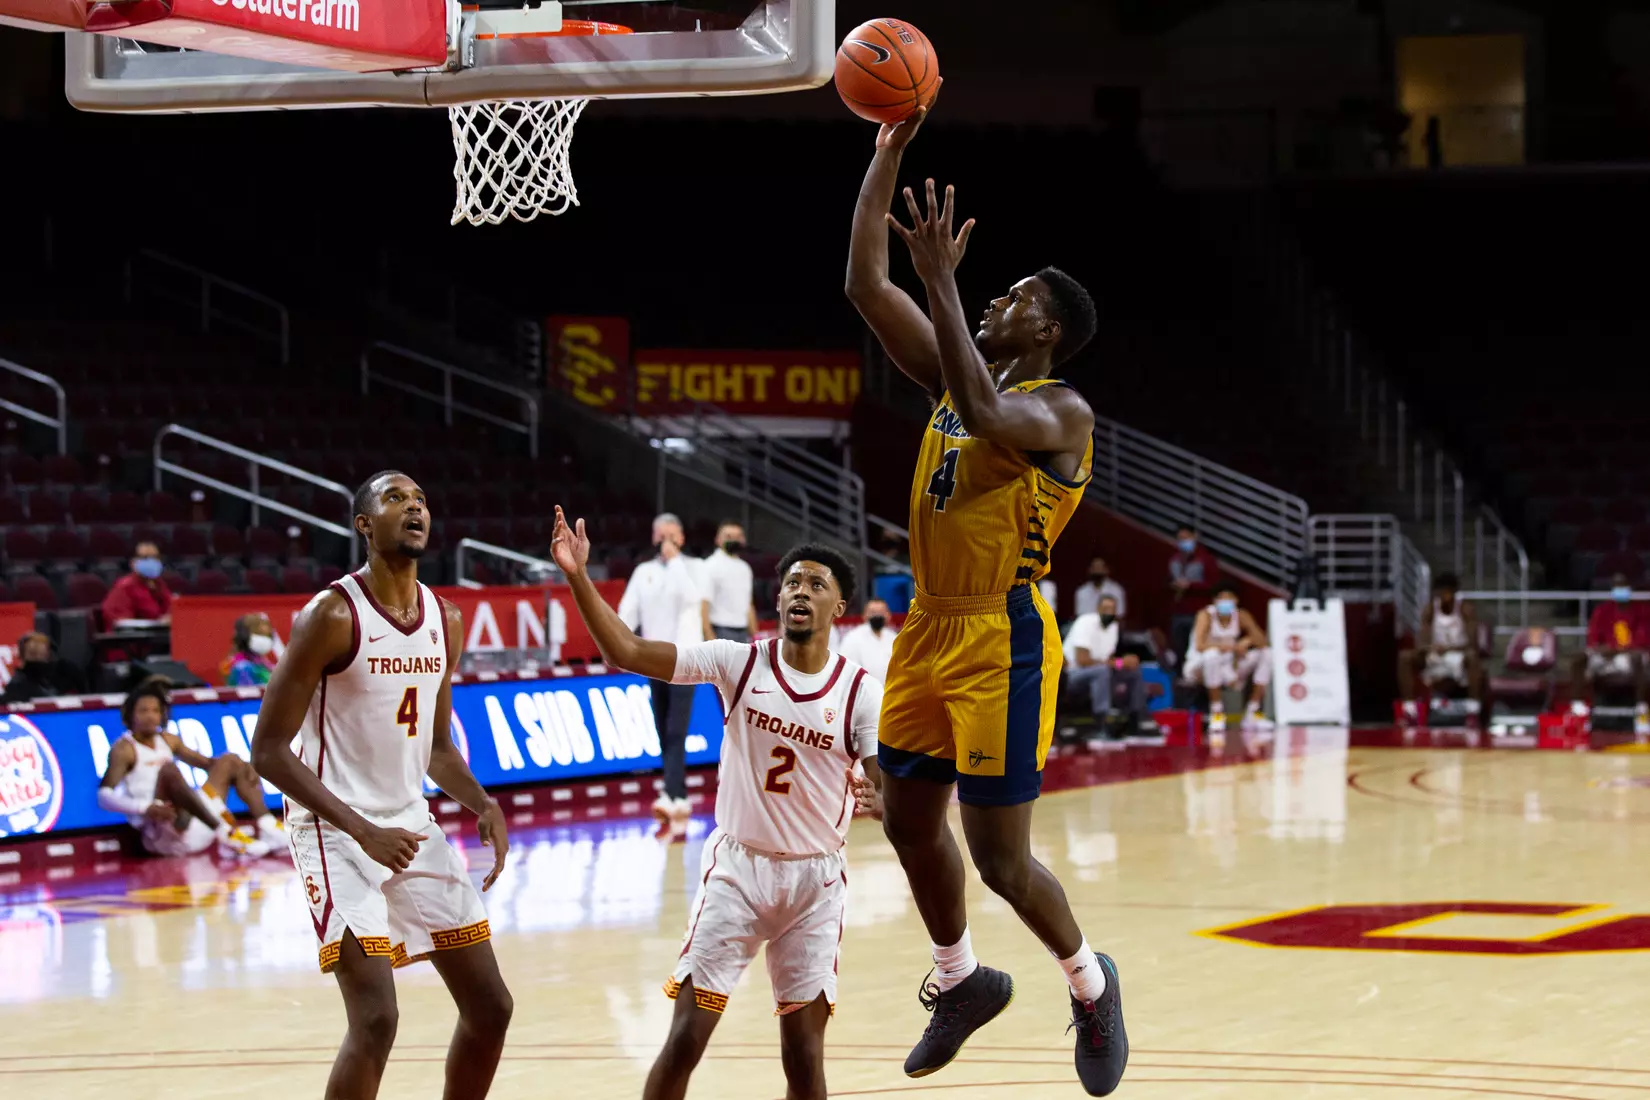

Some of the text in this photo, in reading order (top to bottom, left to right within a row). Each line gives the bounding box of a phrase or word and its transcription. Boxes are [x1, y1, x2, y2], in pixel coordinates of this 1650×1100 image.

[636, 363, 862, 405] FIGHT ON!
[926, 447, 961, 512] 4
[367, 656, 442, 674] TROJANS
[396, 686, 418, 738] 4
[484, 683, 700, 770] A SUB ABO
[746, 706, 835, 751] TROJANS
[764, 745, 797, 795] 2
